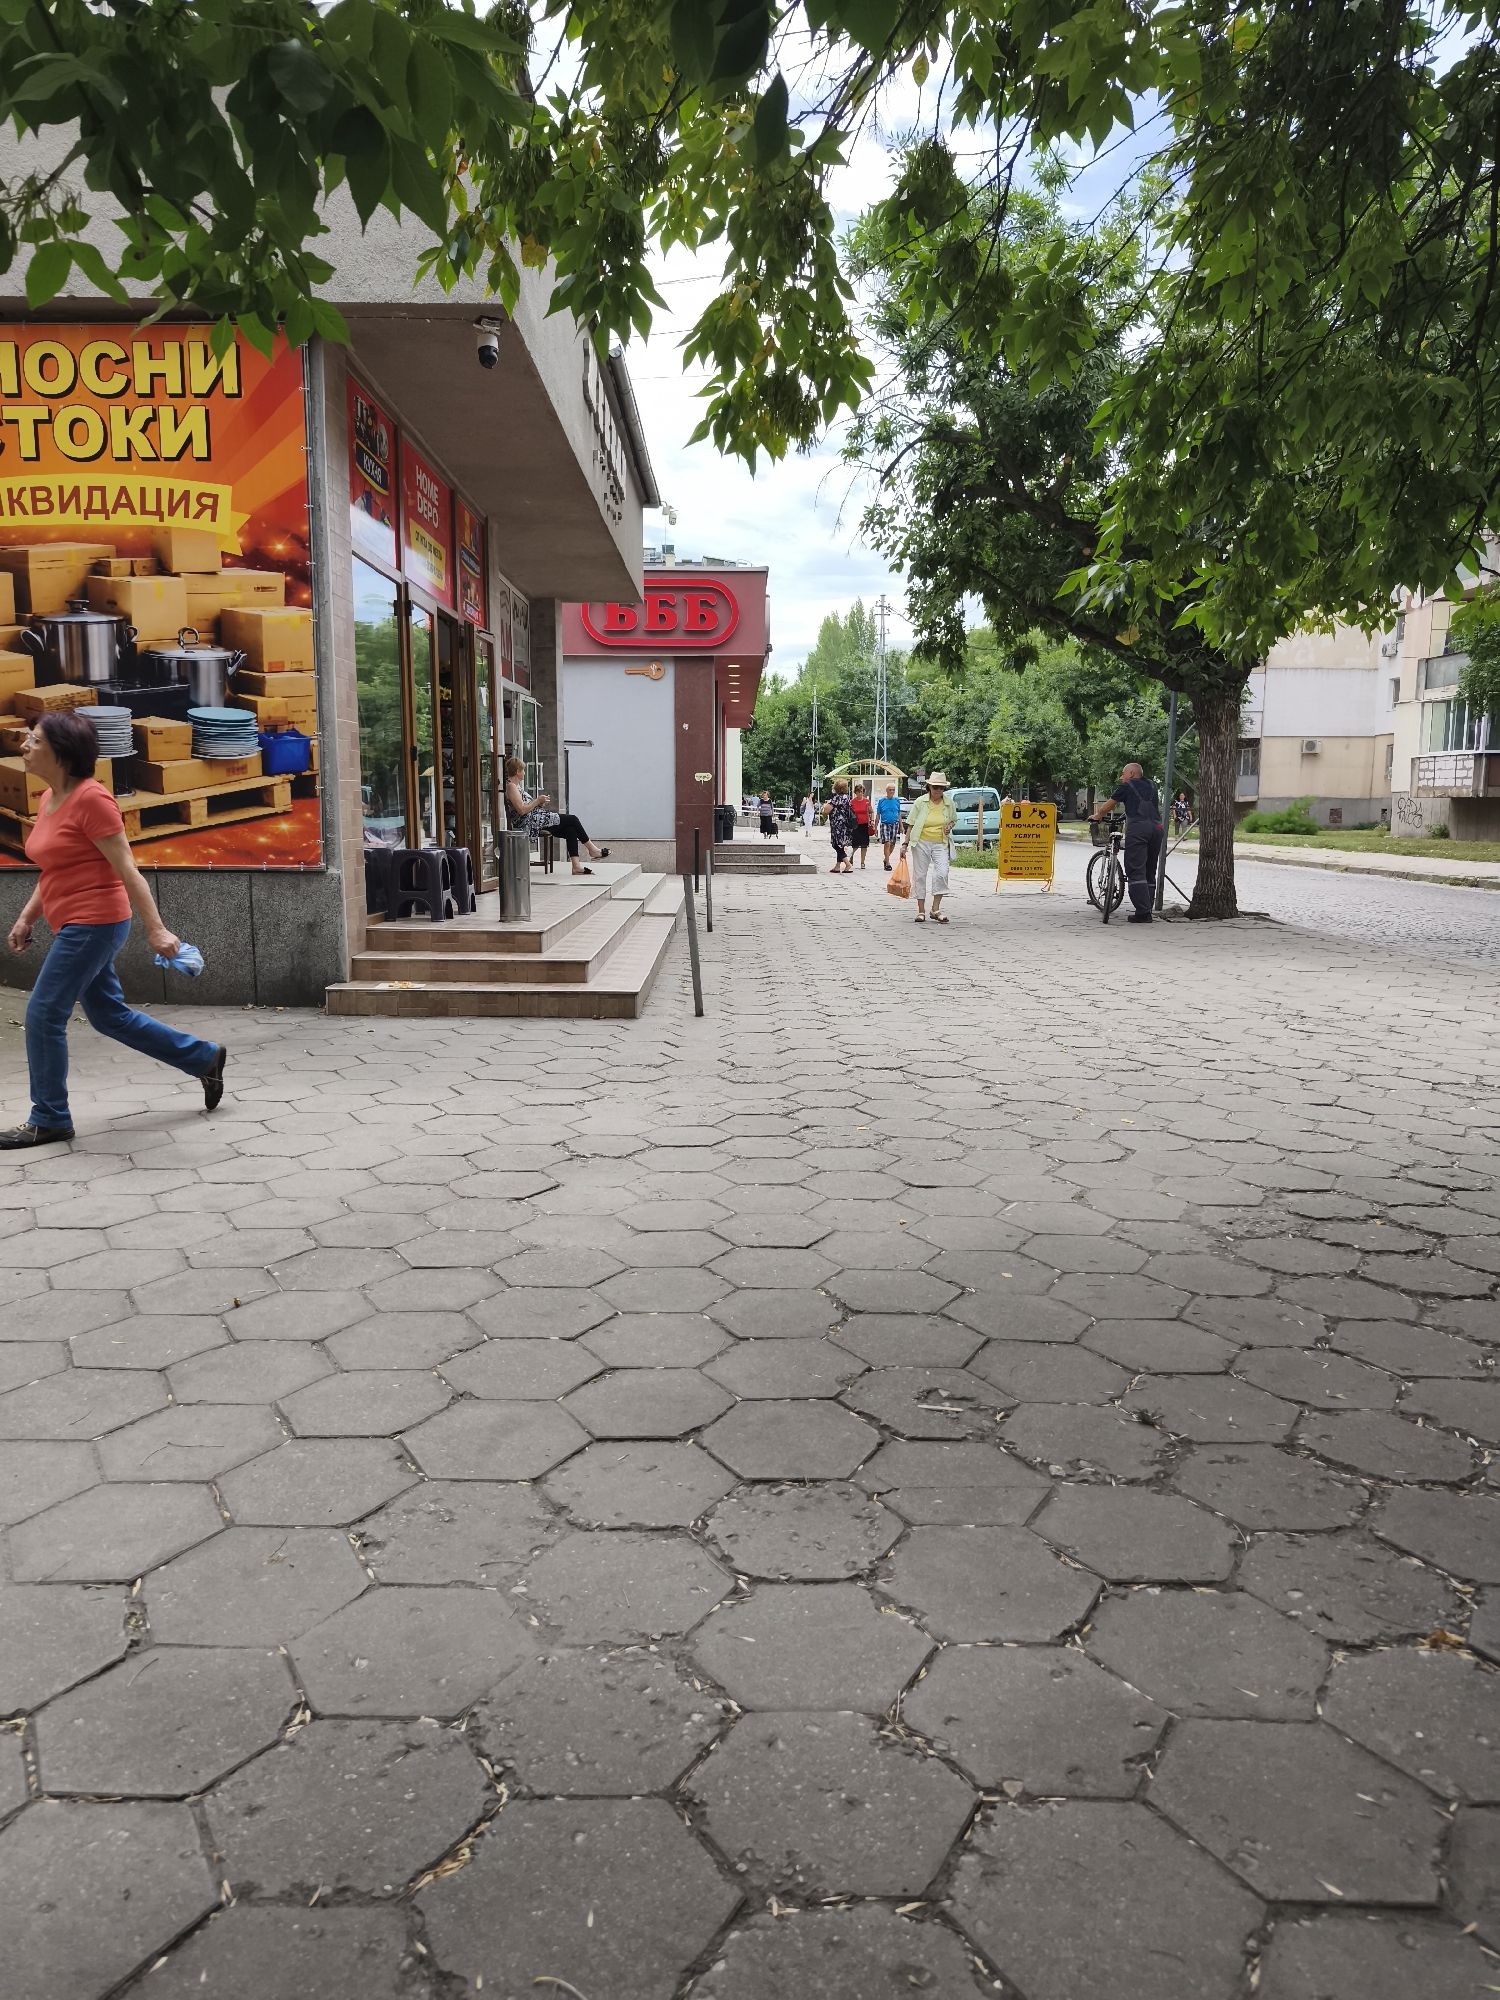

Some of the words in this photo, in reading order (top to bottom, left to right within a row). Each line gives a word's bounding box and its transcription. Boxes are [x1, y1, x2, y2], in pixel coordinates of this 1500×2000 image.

[0, 404, 211, 461] ТОКИ
[0, 485, 219, 522] КВИДАЦИЯ
[415, 464, 439, 507] HOME
[416, 490, 439, 528] DEPO
